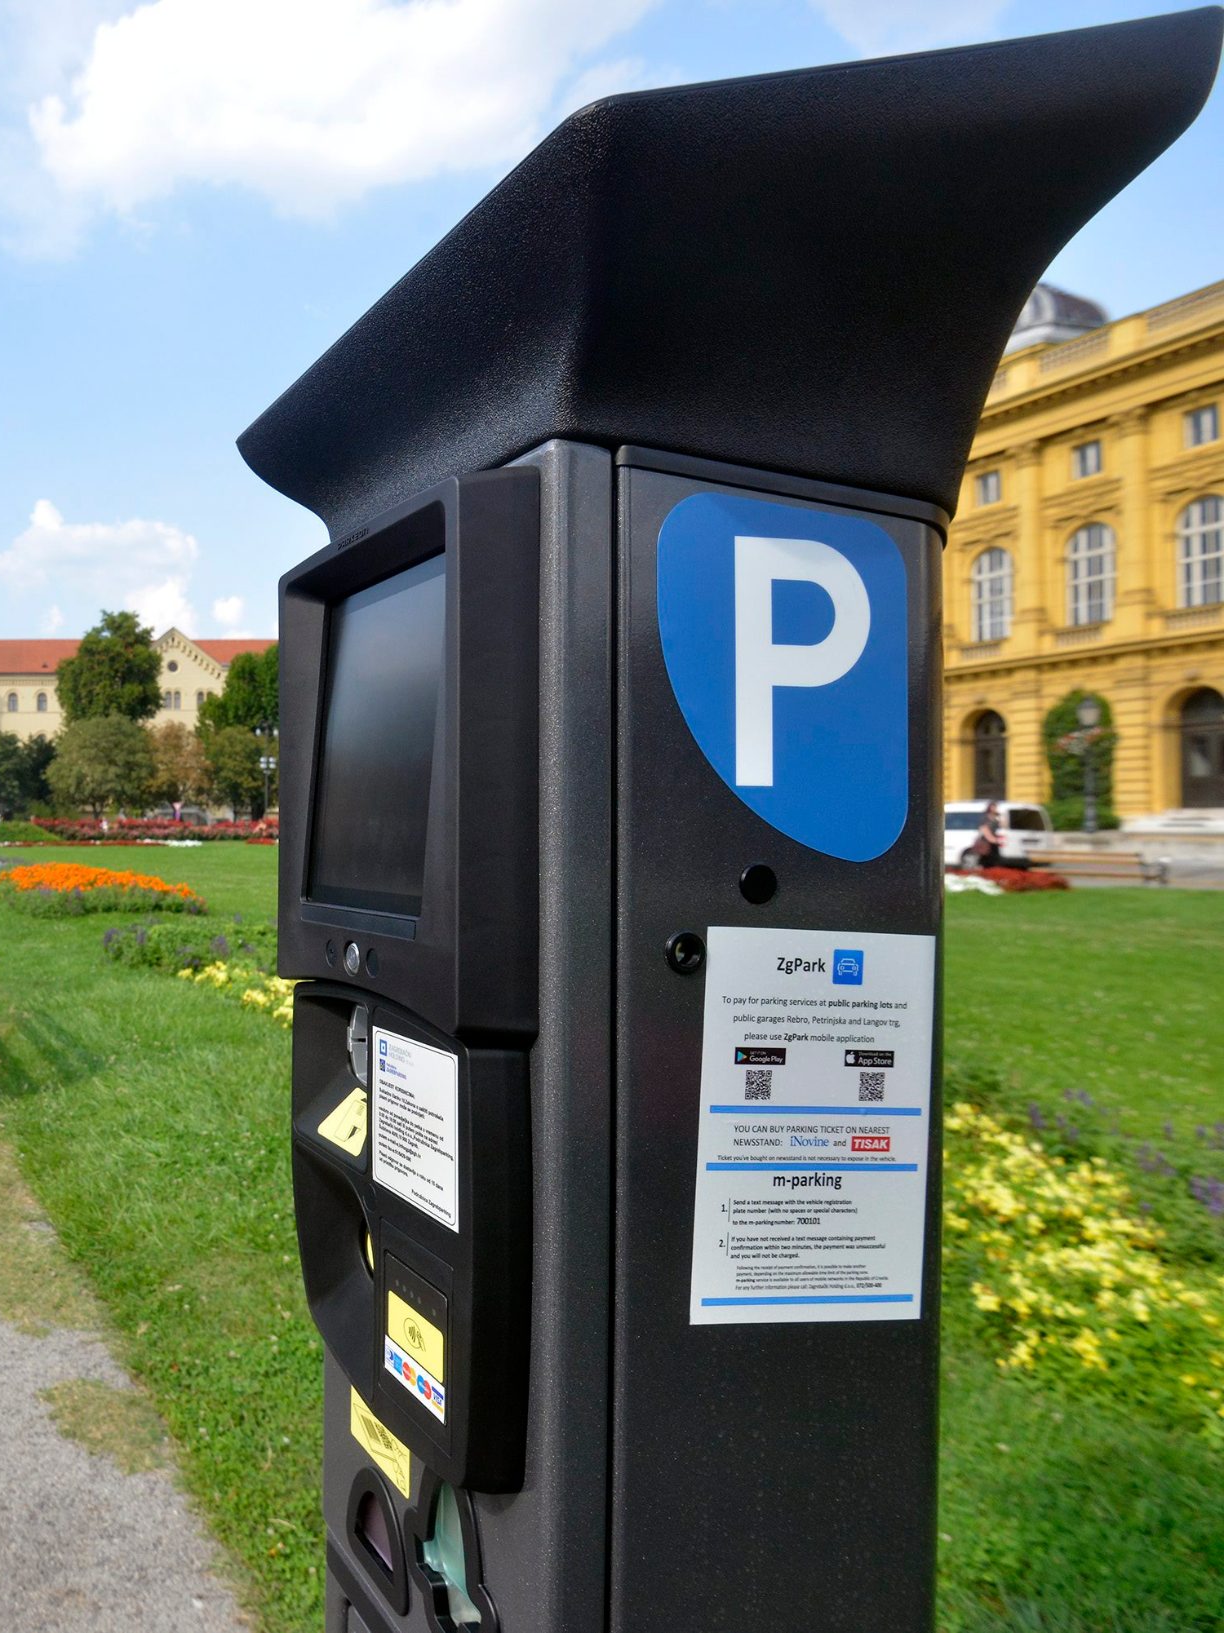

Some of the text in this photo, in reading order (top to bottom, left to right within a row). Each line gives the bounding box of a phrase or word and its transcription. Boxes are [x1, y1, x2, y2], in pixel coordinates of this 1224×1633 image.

[734, 535, 871, 787] P
[776, 956, 825, 975] ZgPark
[732, 997, 746, 1005] pay
[748, 996, 759, 1004] for
[760, 997, 788, 1006] parking
[827, 999, 850, 1008] public
[851, 999, 878, 1009] parking
[732, 1013, 900, 1028] public garages Rebro, Petrinjska and Langov trg,
[743, 1032, 767, 1041] please
[783, 1032, 808, 1042] ZgPark
[809, 1033, 834, 1042] mobile
[835, 1034, 874, 1044] application
[748, 1055, 770, 1063] Google
[857, 1056, 892, 1065] App Store
[819, 1125, 844, 1133] TICKET
[858, 1126, 890, 1134] NEAREST
[733, 1138, 782, 1146] NEWSSTAND:
[853, 1138, 888, 1149] TISAK
[772, 1172, 842, 1189] m-parking
[721, 1203, 727, 1212] 1.
[718, 1239, 725, 1247] 2.
